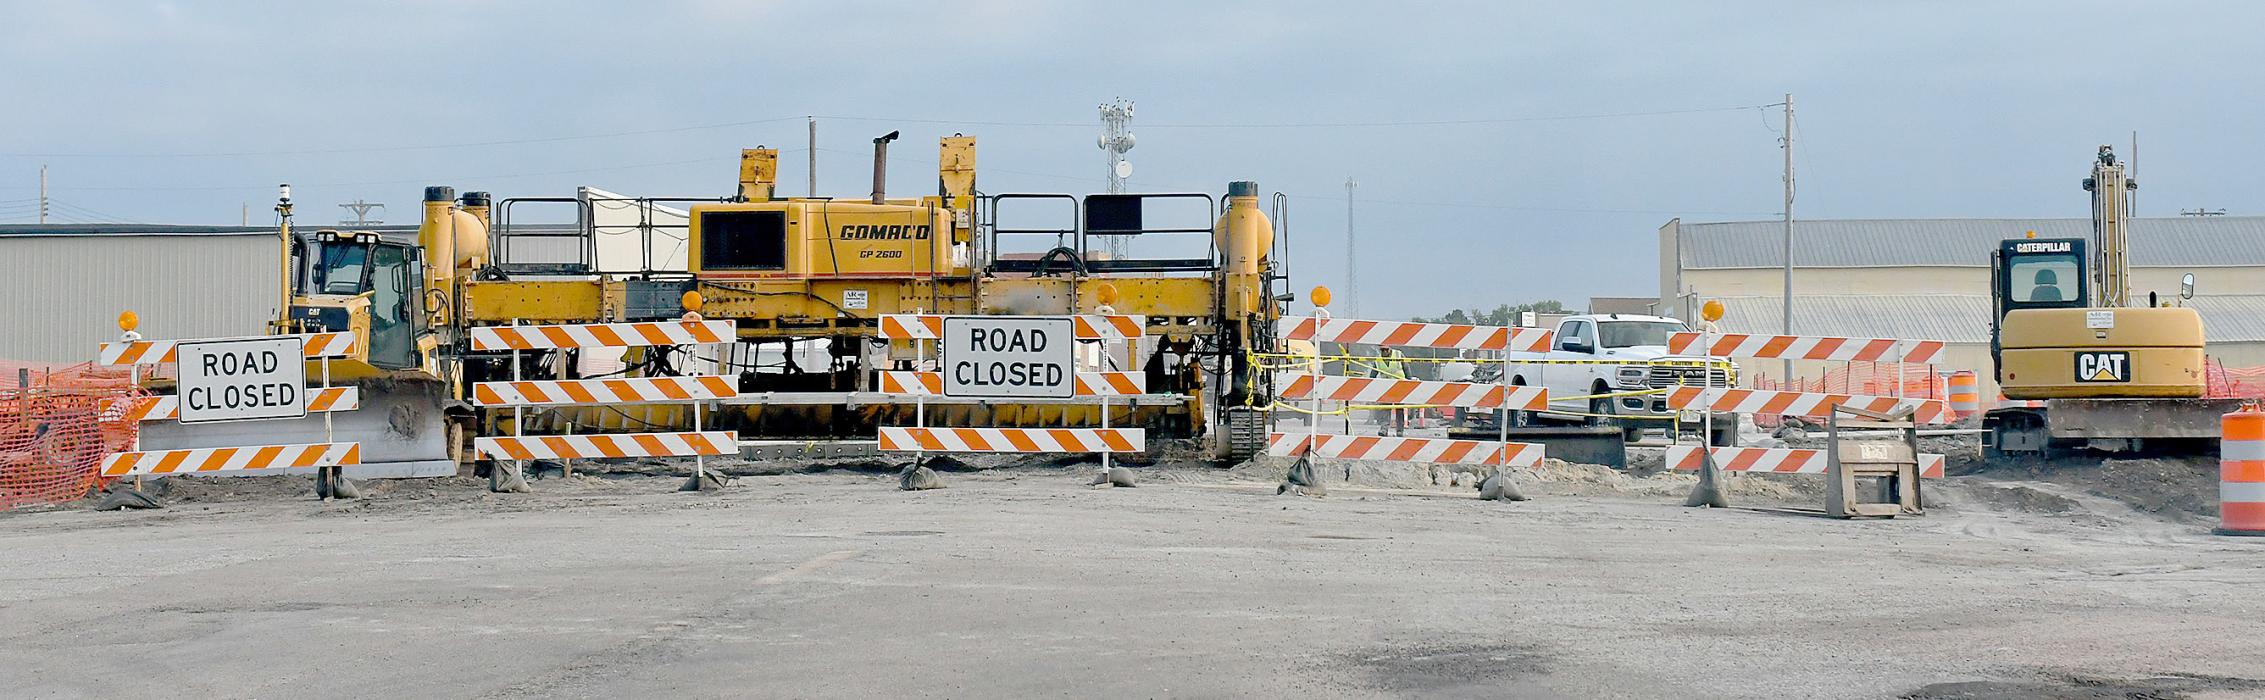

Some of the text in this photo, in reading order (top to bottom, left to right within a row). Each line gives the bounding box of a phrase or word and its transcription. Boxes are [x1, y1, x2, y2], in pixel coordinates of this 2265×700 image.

[840, 224, 930, 240] GOMACO
[860, 250, 902, 258] GP 2600
[2016, 242, 2071, 253] CATERPILLAR
[971, 328, 1047, 352] ROAD
[203, 351, 278, 376] ROAD
[955, 361, 1063, 386] CLOSED
[2080, 353, 2125, 380] CAT
[188, 383, 295, 410] CLOSED
